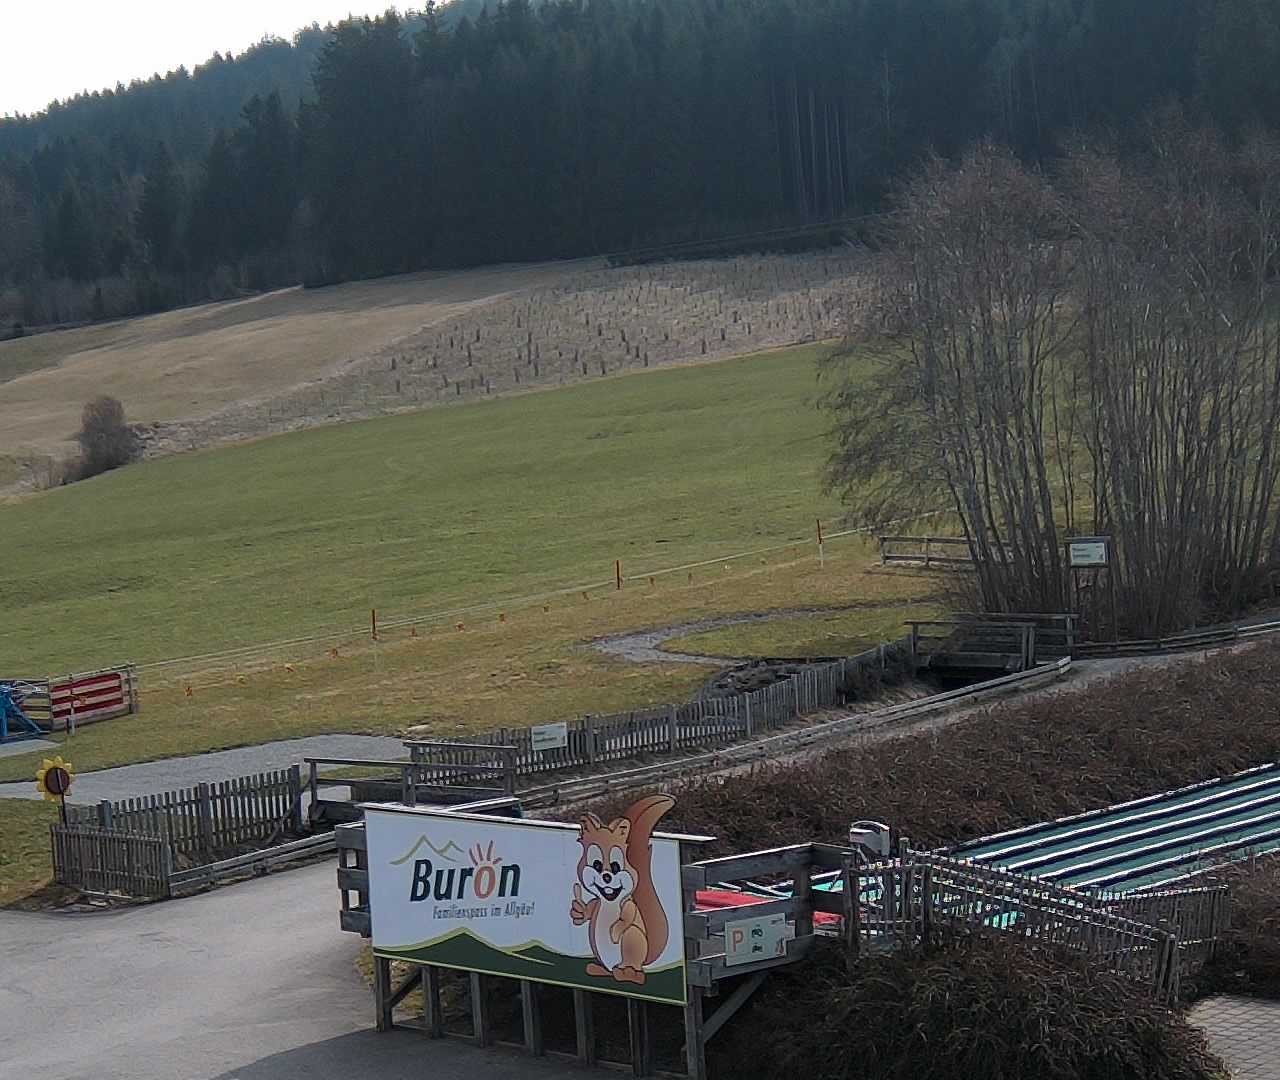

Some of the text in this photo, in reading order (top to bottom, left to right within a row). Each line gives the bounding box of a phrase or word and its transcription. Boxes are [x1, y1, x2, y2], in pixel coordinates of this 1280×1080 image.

[410, 858, 521, 902] Buron
[490, 904, 502, 917] im
[732, 930, 744, 952] P
